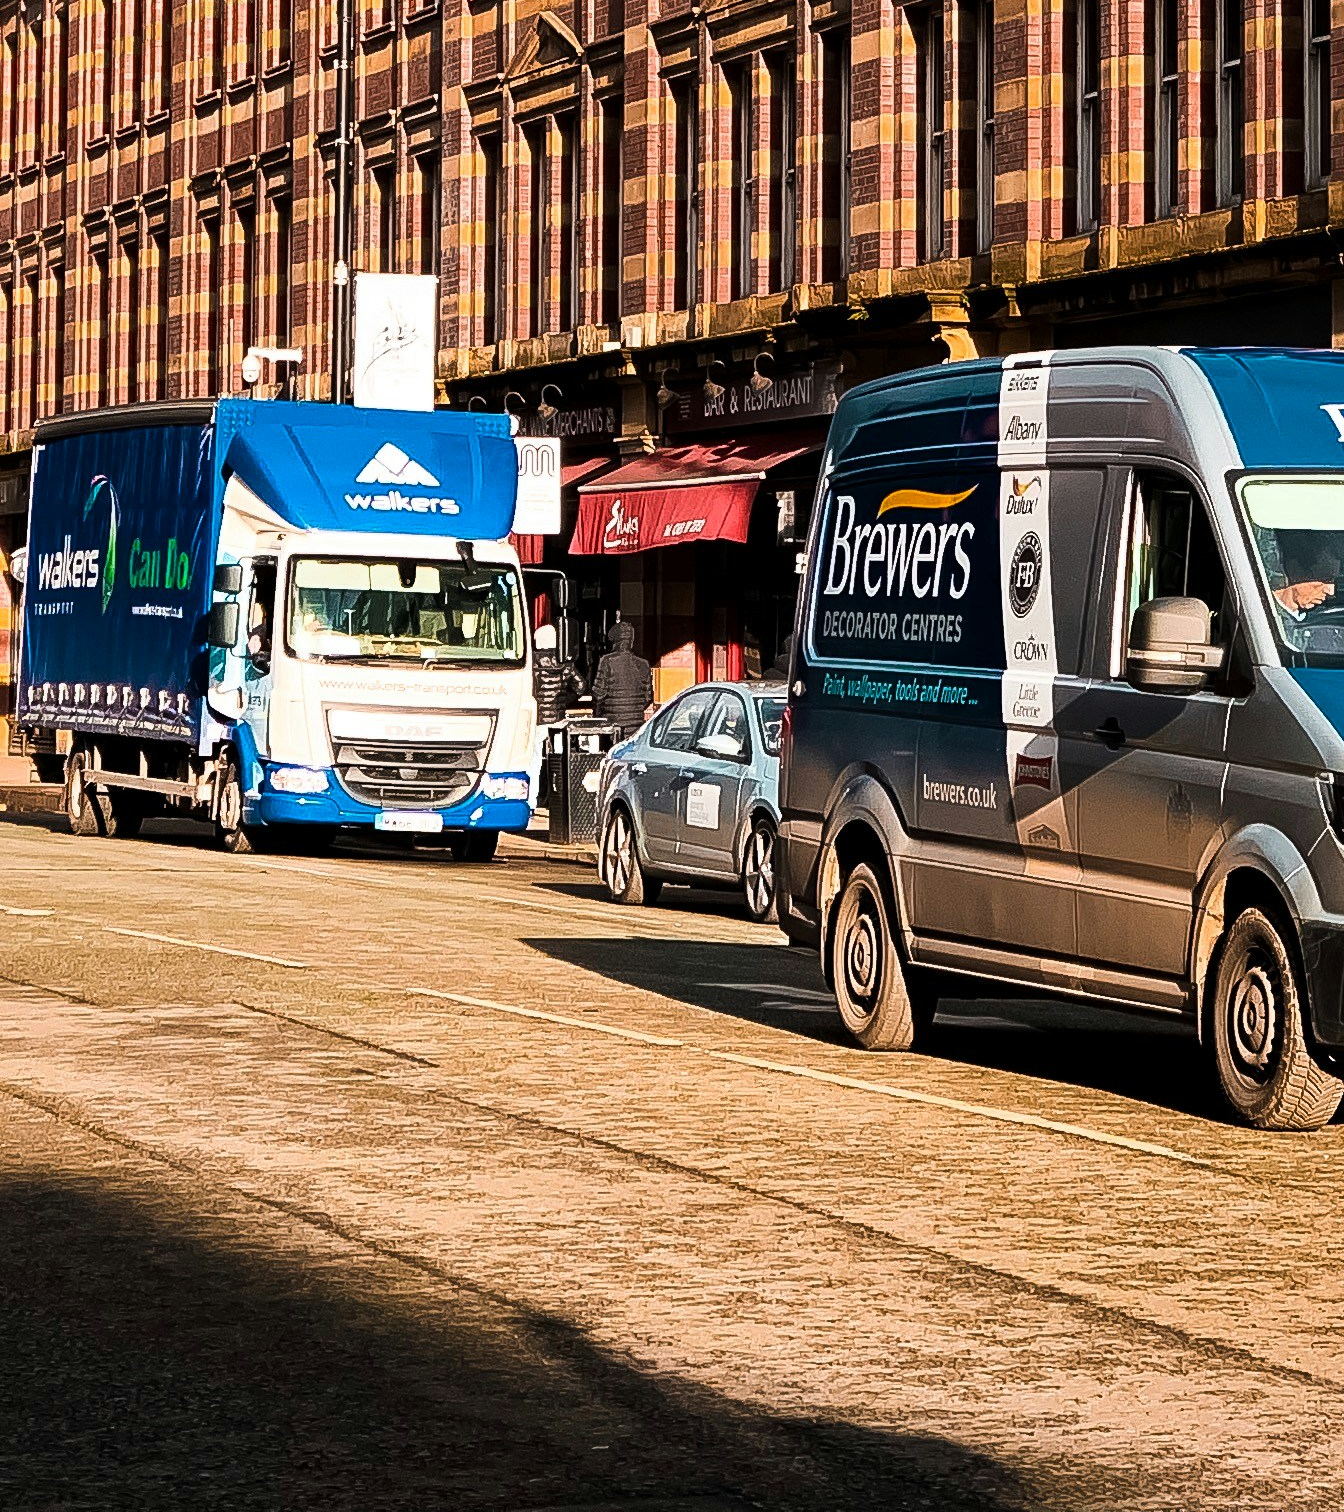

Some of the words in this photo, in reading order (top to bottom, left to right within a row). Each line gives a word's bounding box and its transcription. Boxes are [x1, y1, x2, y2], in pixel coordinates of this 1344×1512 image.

[729, 386, 739, 414] &
[1004, 415, 1043, 446] Albany
[344, 490, 460, 515] walkers
[38, 534, 100, 591] walkers
[823, 495, 976, 600] Brewers
[823, 610, 898, 639] DECORATOR
[902, 613, 963, 642] CENTRES
[1014, 641, 1048, 661] CROWN
[822, 672, 845, 699] Paint,
[847, 674, 893, 705] wallpaper,
[895, 678, 919, 702] tools
[920, 679, 942, 703] and
[923, 773, 997, 809] brewers.co.uk
